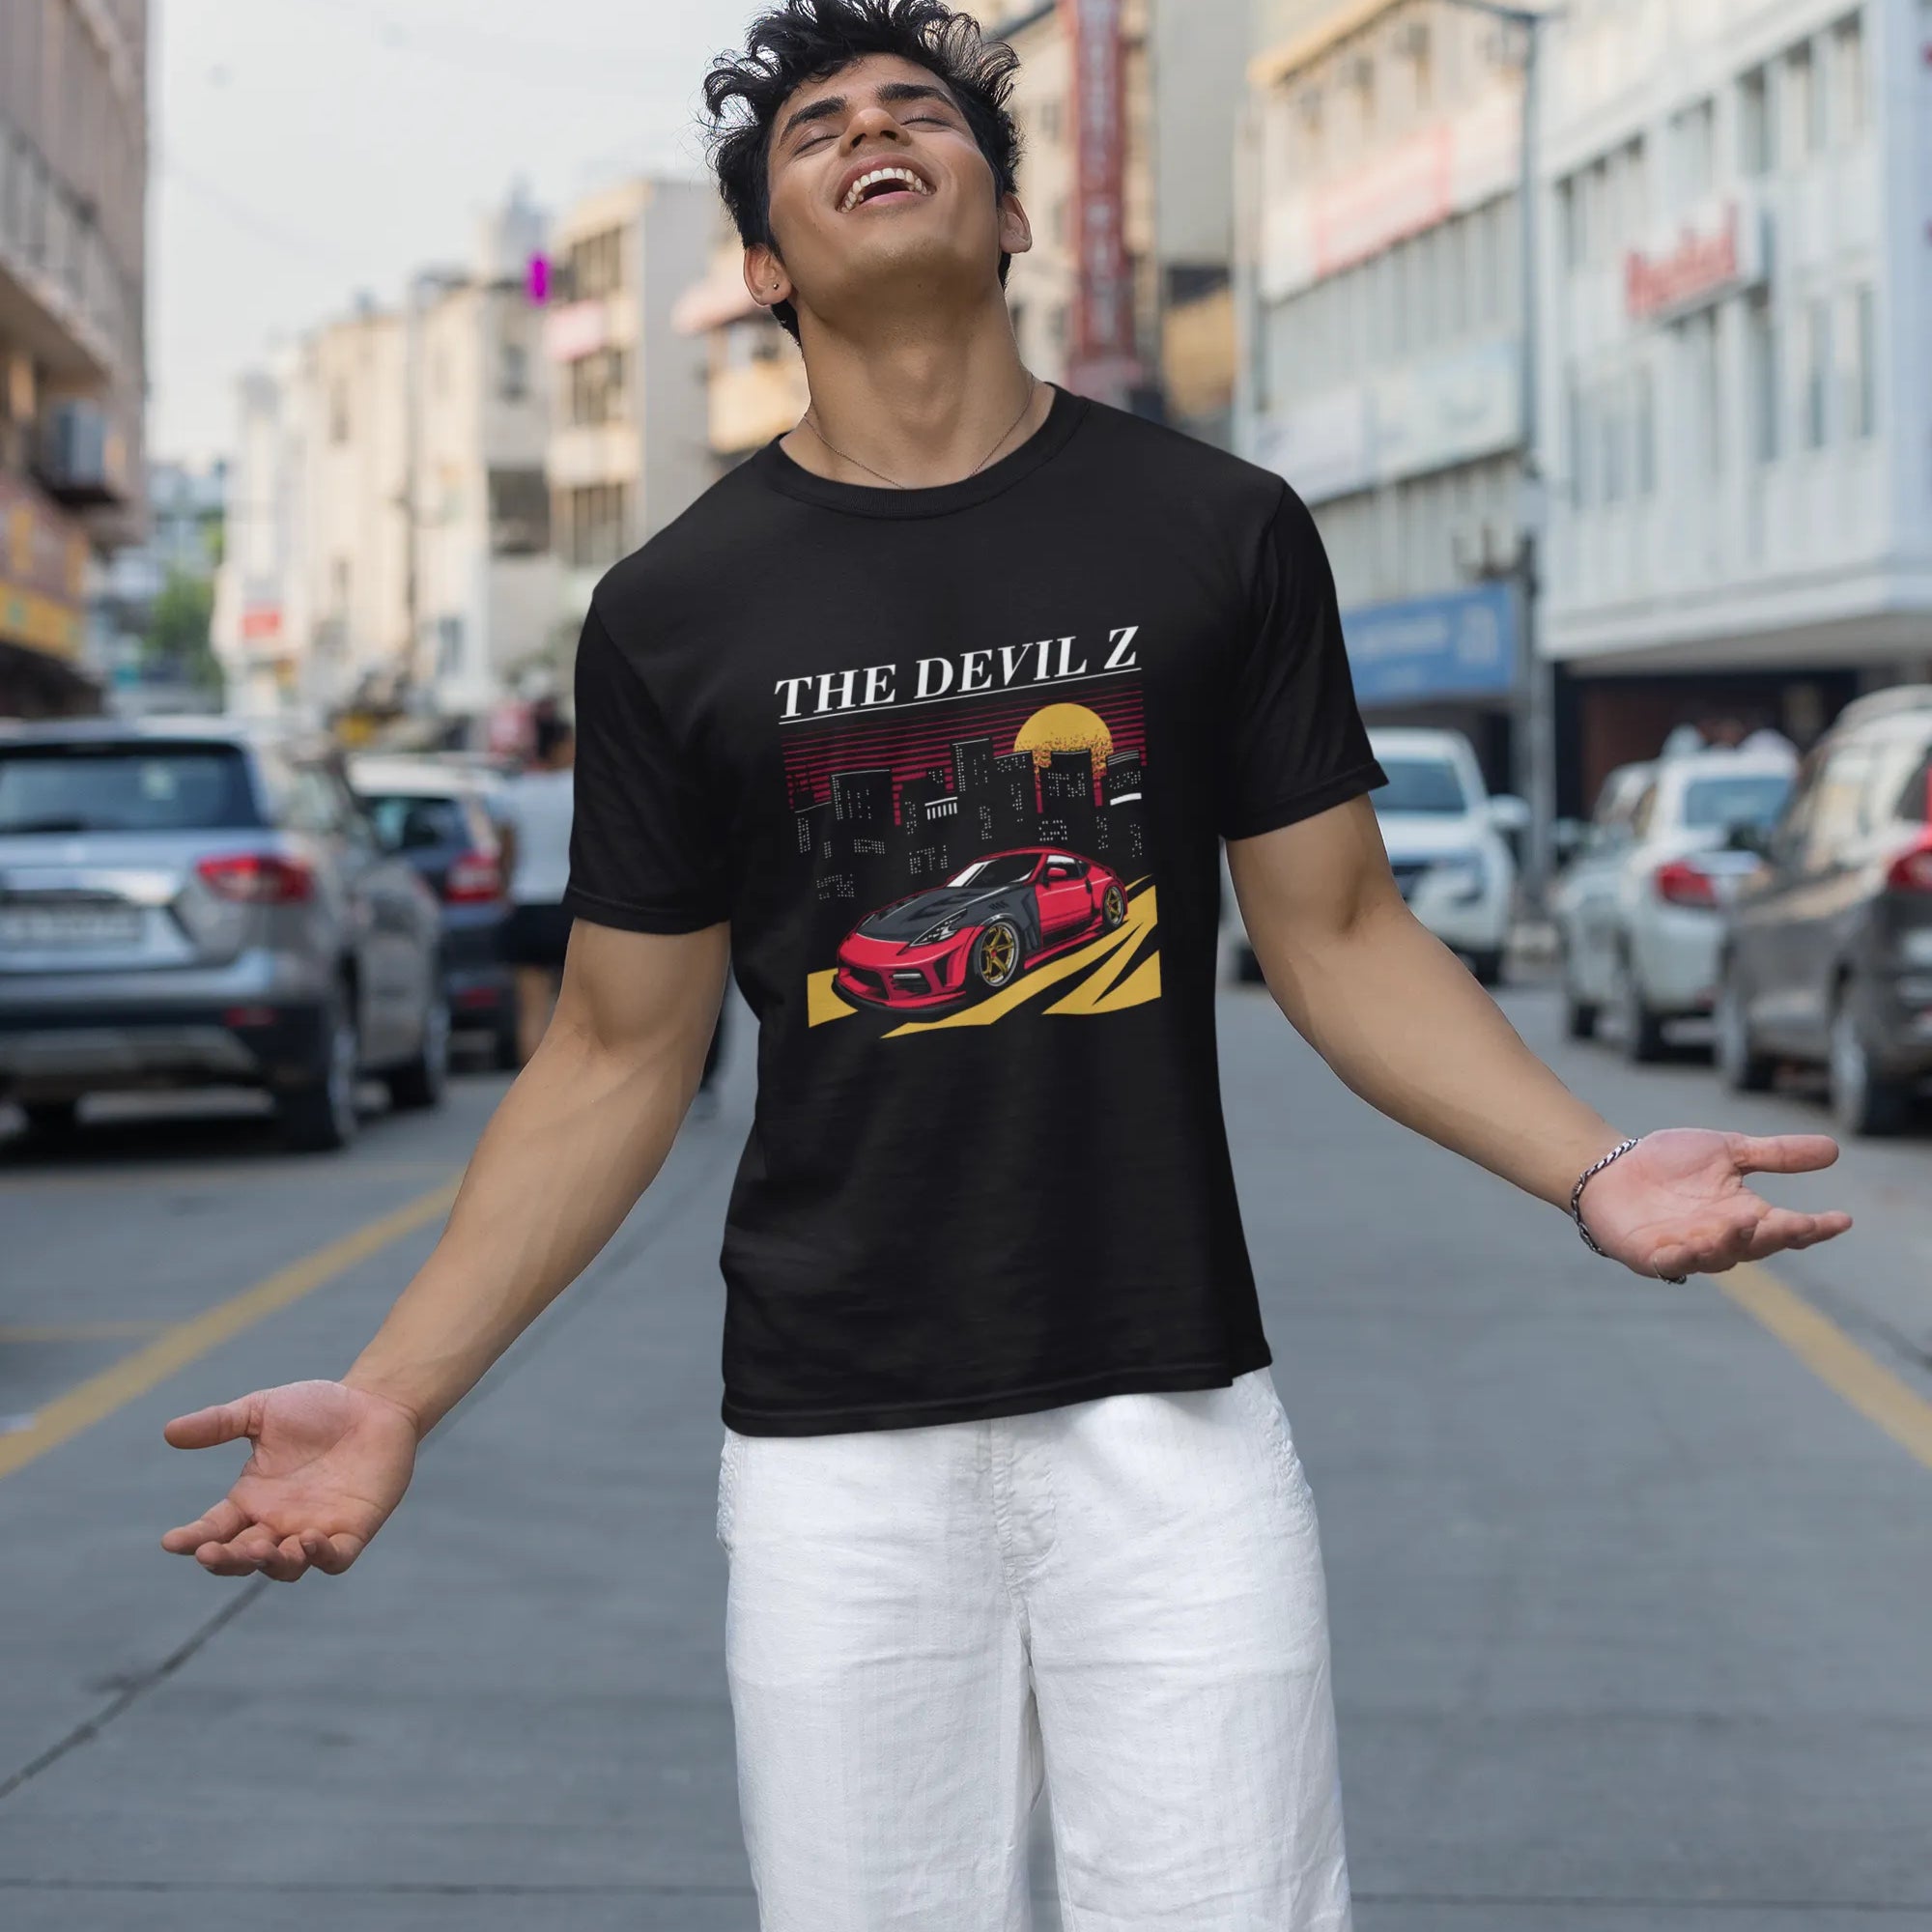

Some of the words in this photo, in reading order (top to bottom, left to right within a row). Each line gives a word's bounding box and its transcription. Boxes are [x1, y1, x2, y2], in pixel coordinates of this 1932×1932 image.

[774, 664, 896, 719] THE
[914, 636, 1088, 699] DEVIL
[1103, 625, 1139, 669] Z
